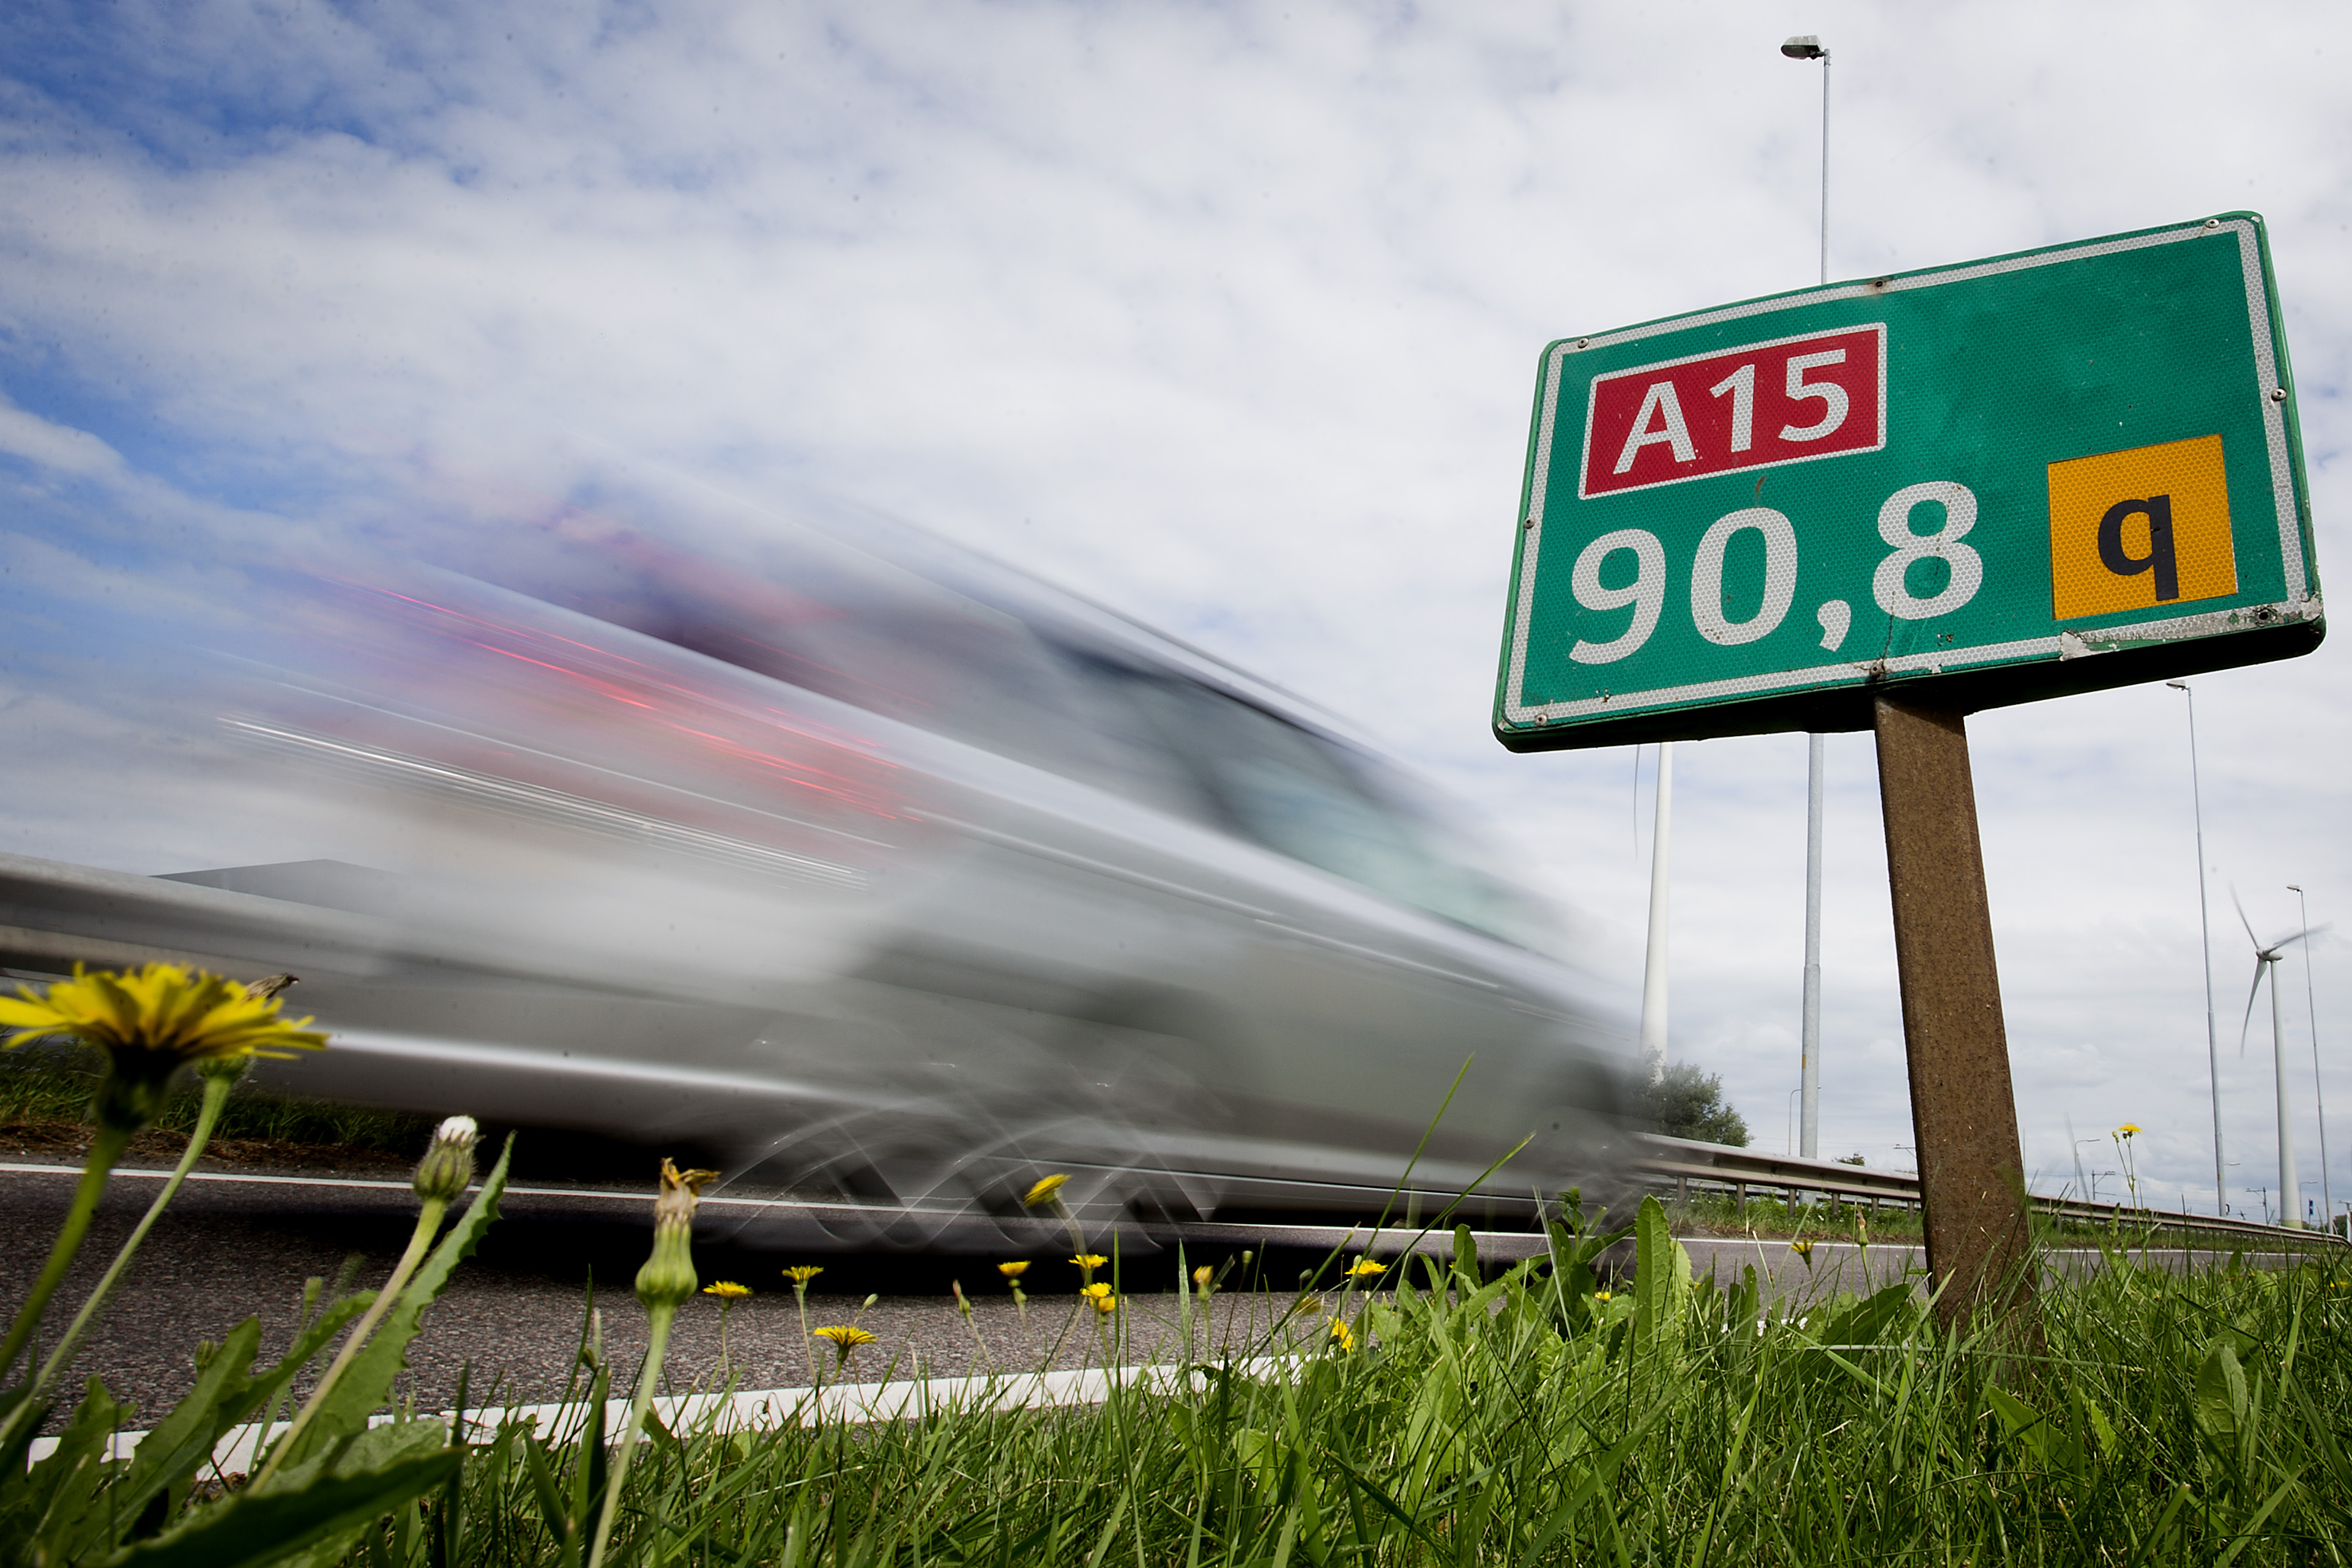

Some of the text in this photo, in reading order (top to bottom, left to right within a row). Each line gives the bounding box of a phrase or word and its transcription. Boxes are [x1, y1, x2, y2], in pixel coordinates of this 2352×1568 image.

[1613, 349, 1850, 474] A15
[1569, 481, 1984, 664] 90,8
[2097, 494, 2179, 601] q
